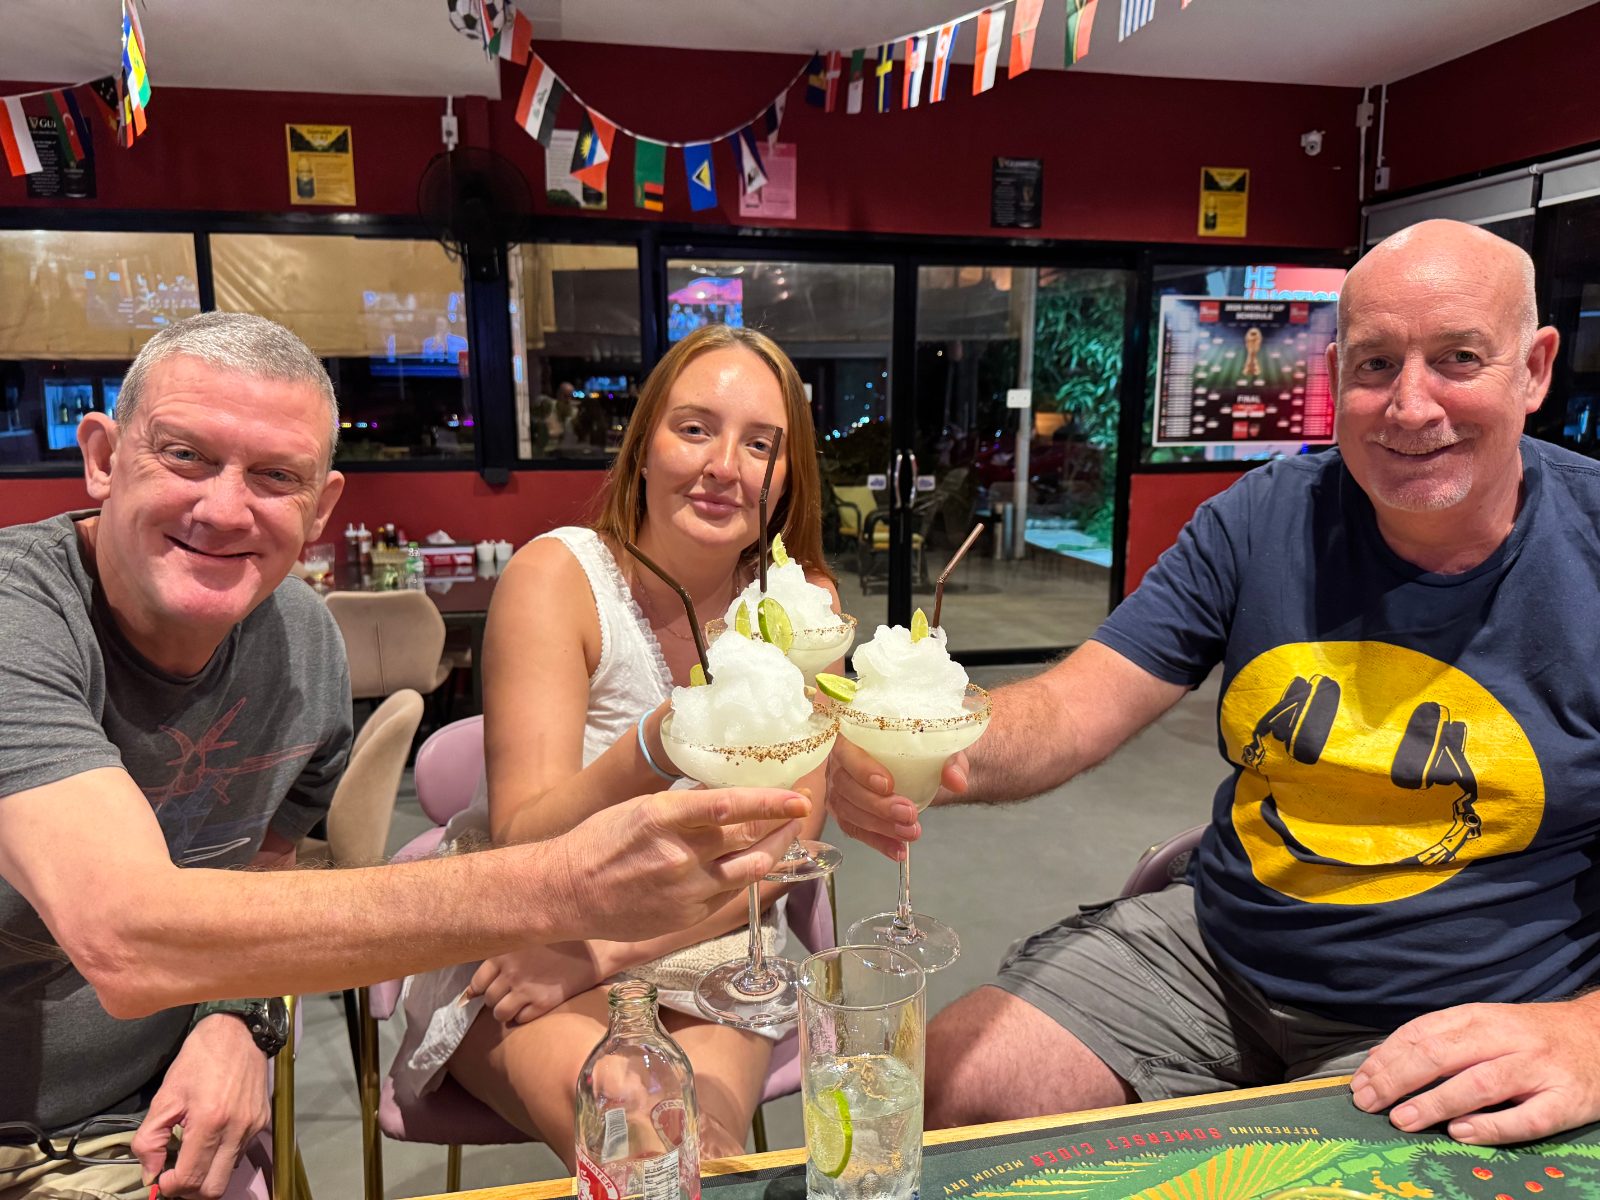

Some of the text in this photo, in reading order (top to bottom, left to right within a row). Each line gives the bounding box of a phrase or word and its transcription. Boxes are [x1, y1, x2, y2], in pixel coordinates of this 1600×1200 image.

[1236, 394, 1261, 404] FINAL
[1229, 1126, 1319, 1136] REFRESHING
[1030, 1127, 1222, 1167] SOMERSET CIDER
[943, 1159, 1025, 1195] MEDIUM DRY
